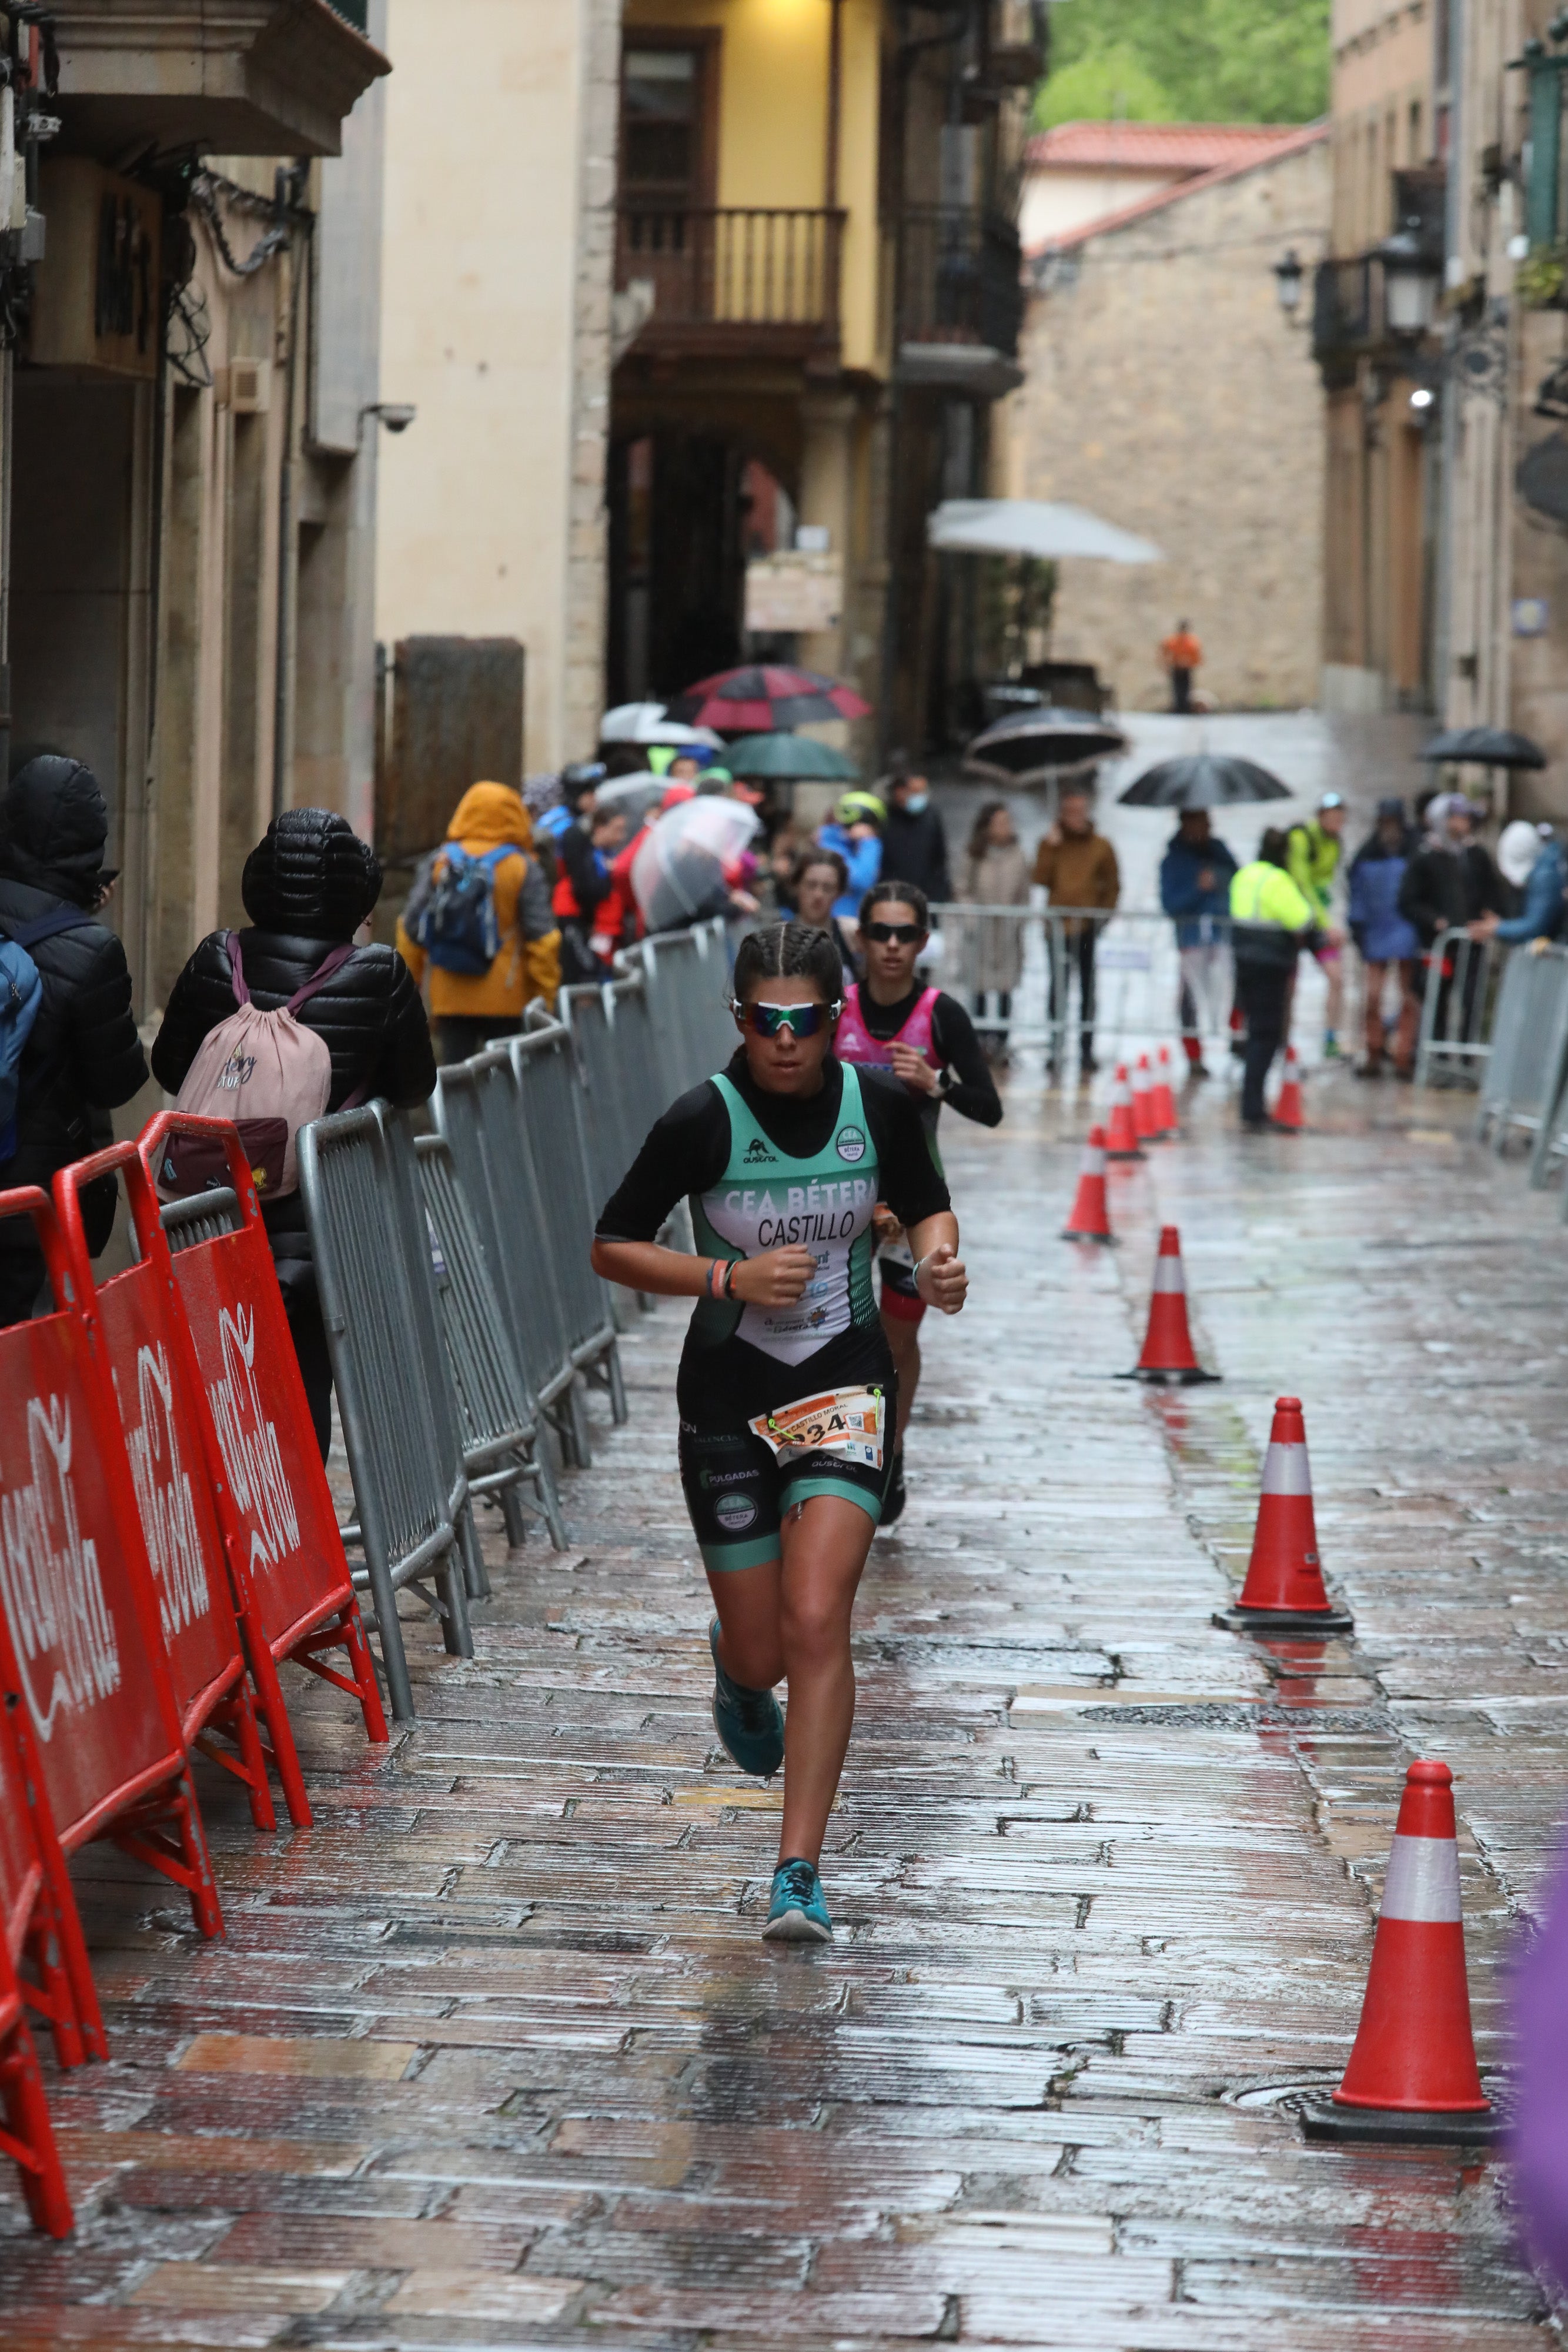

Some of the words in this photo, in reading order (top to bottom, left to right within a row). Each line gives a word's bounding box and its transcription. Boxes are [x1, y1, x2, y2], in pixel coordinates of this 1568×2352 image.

[842, 1130, 858, 1139] CEA
[725, 1190, 777, 1220] CEA
[758, 1211, 854, 1247] CASTILLO
[791, 1412, 823, 1432] CASTILLO
[824, 1404, 848, 1416] MORAL
[708, 1469, 760, 1483] PULGADAS
